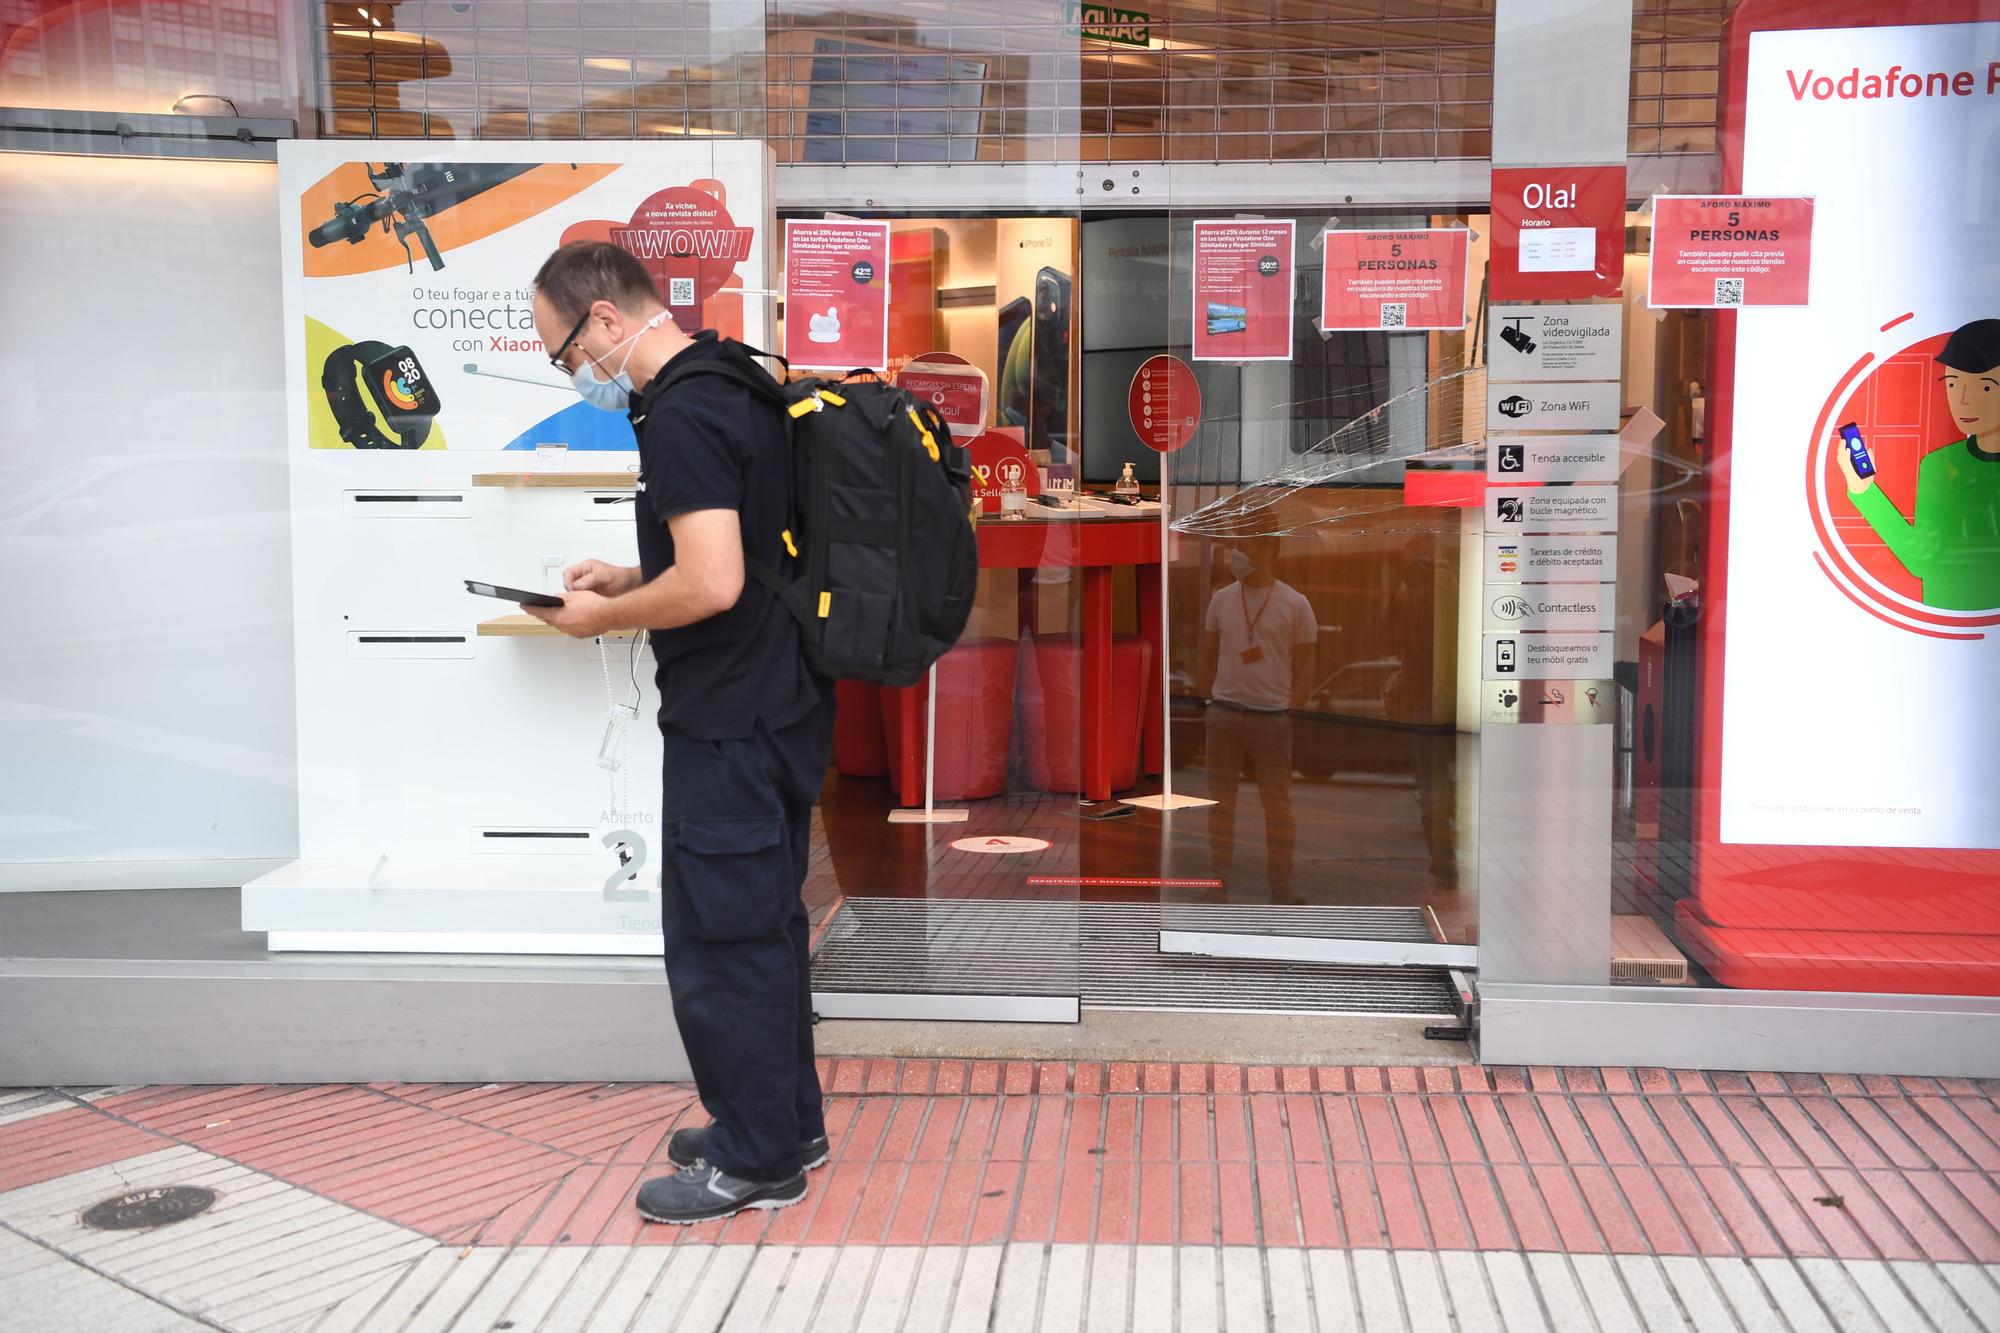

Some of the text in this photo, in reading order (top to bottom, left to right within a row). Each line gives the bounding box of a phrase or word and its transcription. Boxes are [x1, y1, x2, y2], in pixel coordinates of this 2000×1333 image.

[1786, 66, 1975, 101] Vodafone
[1523, 183, 1576, 209] Ola!
[665, 202, 697, 210] Xa viches
[668, 209, 692, 217] revista
[1522, 219, 1551, 227] Horario
[1727, 212, 1740, 227] 5
[793, 229, 813, 237] Ahorra
[813, 229, 819, 237] el
[1690, 230, 1780, 241] PERSONAS
[829, 236, 857, 244] Vodafone
[1024, 239, 1045, 248] iPhone
[1391, 244, 1402, 257] 5
[1679, 249, 1708, 257] También
[1708, 250, 1732, 258] puedes
[1733, 250, 1750, 258] pedir
[1763, 250, 1785, 258] previa
[1358, 260, 1438, 271] PERSONAS
[1685, 258, 1722, 266] cualquiera
[1374, 278, 1396, 286] puedes
[1423, 278, 1442, 286] previa
[413, 287, 424, 300] O
[428, 289, 449, 300] teu
[453, 287, 489, 303] fogar
[492, 290, 500, 300] e
[503, 290, 511, 300] a
[413, 304, 534, 330] conecta
[1543, 316, 1569, 326] Zona
[1542, 326, 1610, 339] videovigilada
[452, 336, 543, 352] con Xiaom
[398, 357, 415, 373] 08
[404, 368, 421, 384] 20
[906, 379, 977, 391] RECARGAS SIN ESPERA
[1541, 401, 1590, 411] Zona WiFi
[1532, 453, 1606, 462] Tenda accesible
[980, 488, 1001, 497] Selle
[1530, 497, 1551, 505] Zona
[1552, 497, 1589, 506] equipada
[1530, 507, 1598, 516] bucle magnético
[1529, 548, 1561, 556] Tarxetas
[1574, 548, 1602, 556] crédito
[1536, 558, 1561, 566] débito
[1562, 558, 1604, 567] aceptadas
[1538, 602, 1597, 613] Contactless
[1527, 644, 1591, 654] Desbloqueamos
[1527, 656, 1589, 666] teu móbil gratis
[1886, 806, 1897, 815] de
[1898, 806, 1922, 815] venta
[600, 810, 654, 824] Abierto
[601, 829, 662, 903] 2
[618, 916, 661, 929] Tiend
